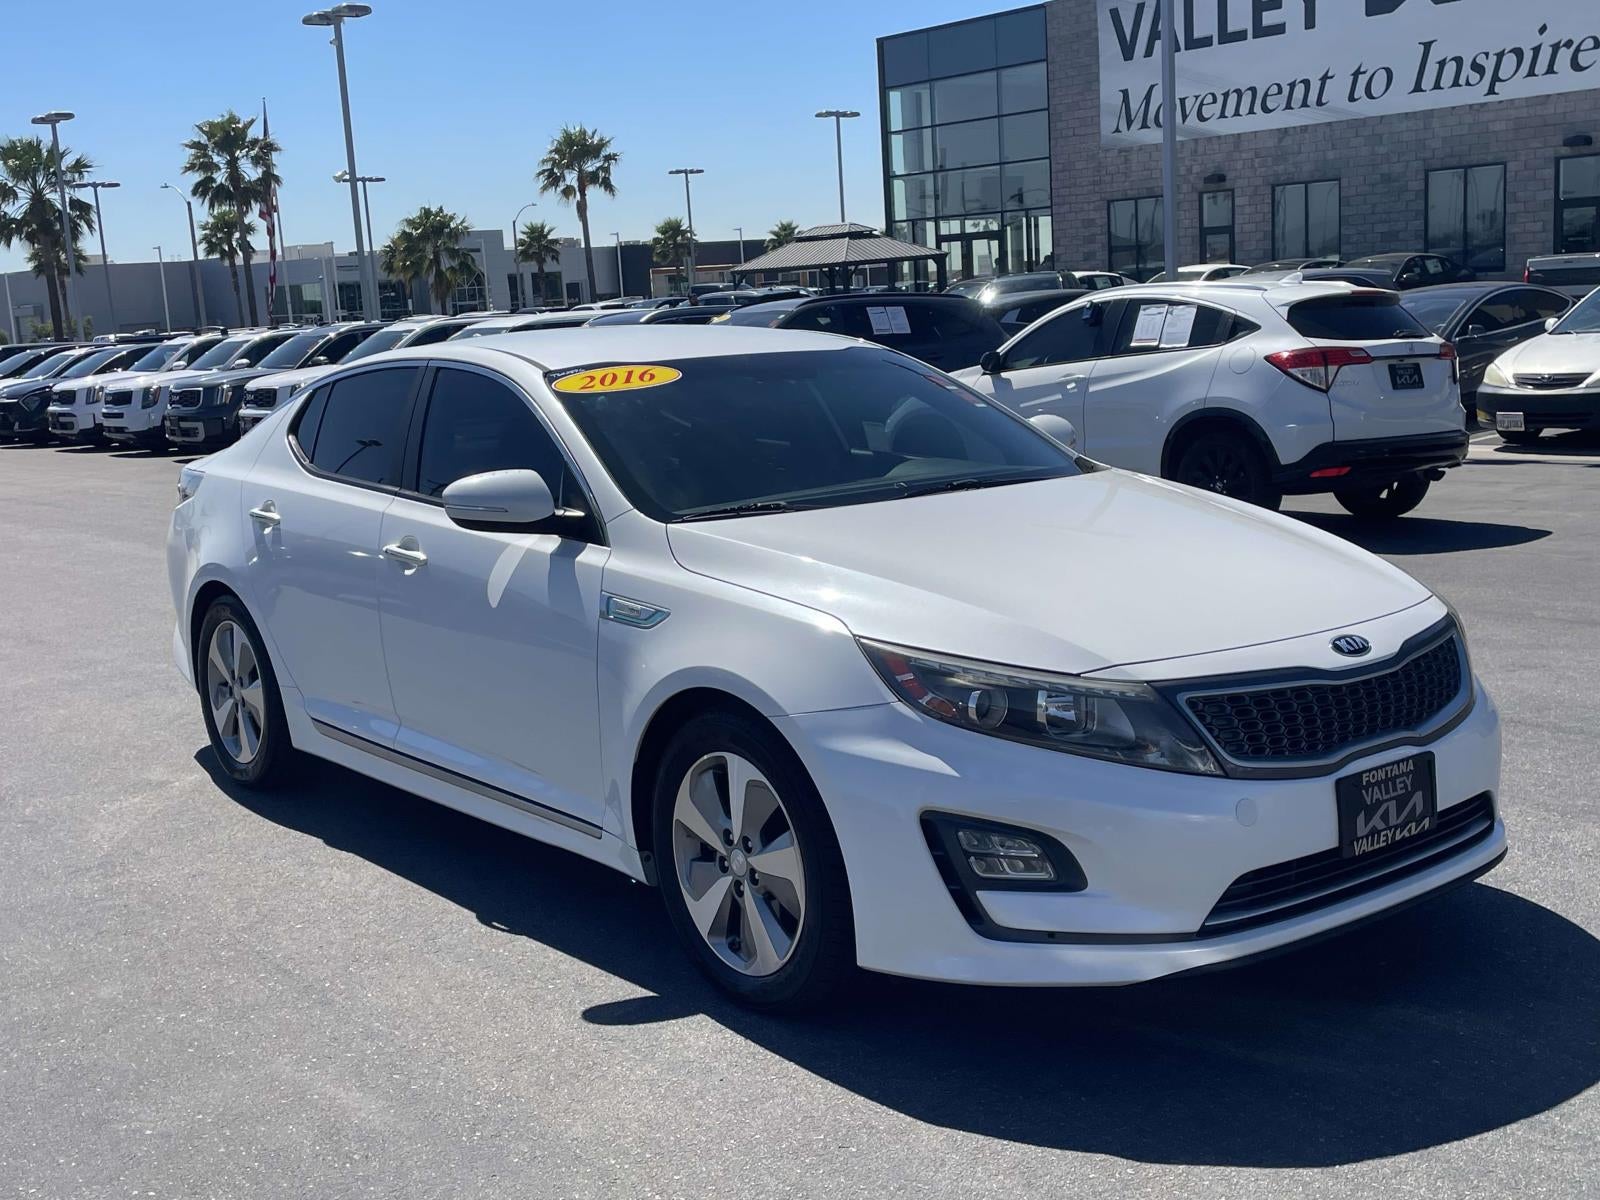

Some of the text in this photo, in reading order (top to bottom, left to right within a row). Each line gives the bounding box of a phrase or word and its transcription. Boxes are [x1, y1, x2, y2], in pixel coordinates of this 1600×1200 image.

[1347, 63, 1394, 102] to
[1408, 23, 1600, 96] Inspire
[579, 367, 656, 390] 2016
[1334, 636, 1369, 653] KIA
[1362, 759, 1414, 786] FONTANA
[1362, 774, 1413, 806] VALLEY
[1356, 790, 1424, 838] KIA
[1353, 828, 1395, 857] VALLEY
